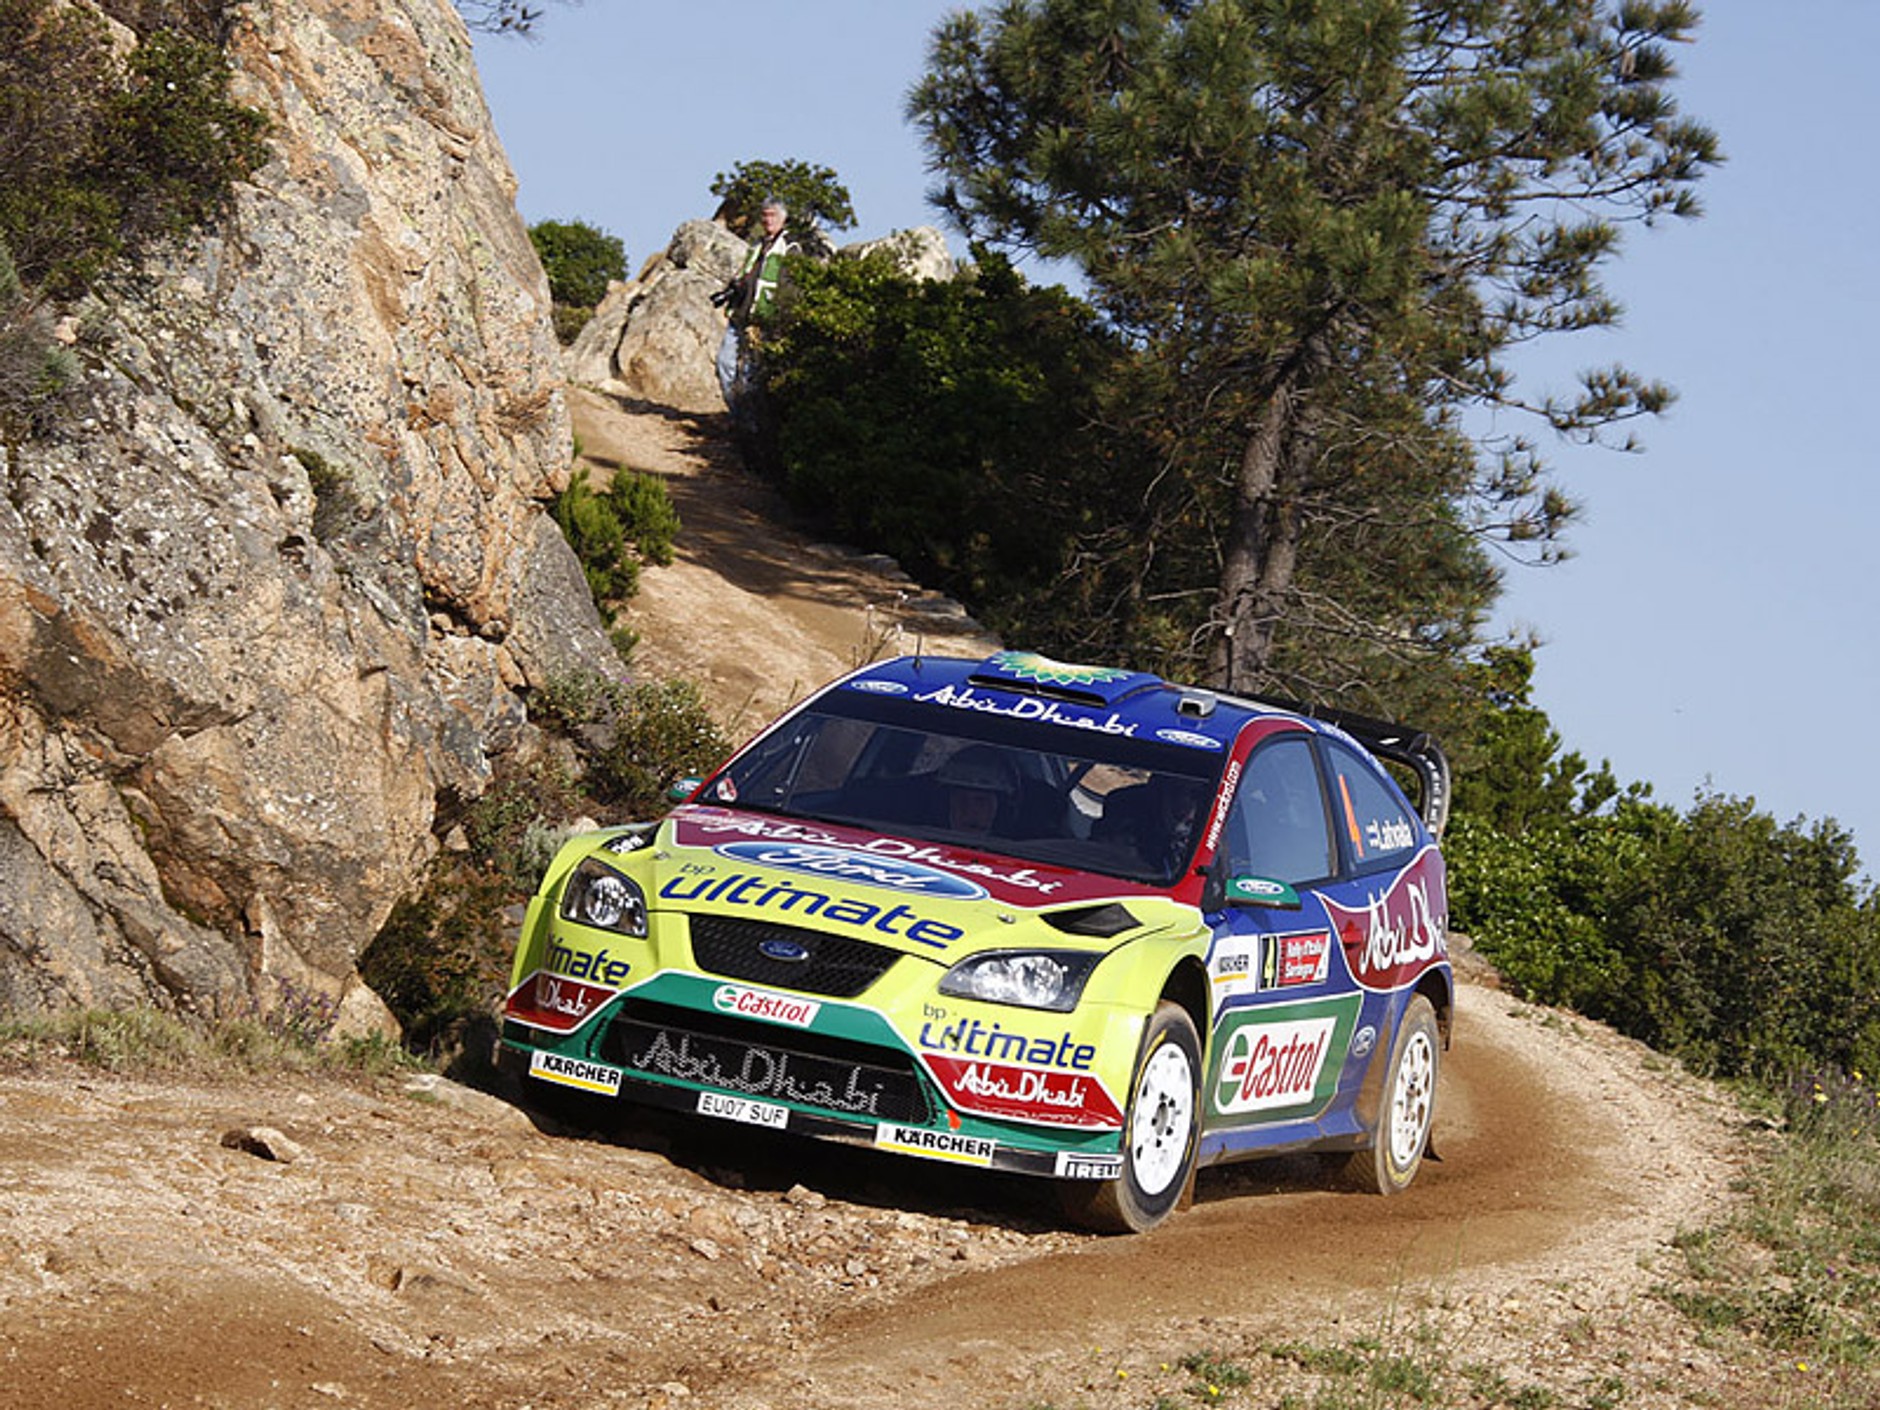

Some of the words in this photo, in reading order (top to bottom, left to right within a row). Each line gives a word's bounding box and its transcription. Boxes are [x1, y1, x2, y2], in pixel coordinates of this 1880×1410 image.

[913, 685, 1002, 715] Abu
[1008, 697, 1139, 738] Dhabi
[679, 861, 716, 877] bp
[757, 845, 942, 889] Ford
[863, 838, 1064, 895] Dhabi
[659, 874, 965, 950] ultimate
[737, 991, 810, 1023] Castrol
[923, 1003, 947, 1020] bp
[919, 1018, 1097, 1070] ultimate
[1241, 1029, 1327, 1101] Castrol
[542, 1054, 620, 1086] KÄRCHER
[741, 1048, 884, 1115] Dhabi
[953, 1063, 1015, 1100] Abu
[1018, 1071, 1087, 1108] Dhabi
[701, 1095, 746, 1117] EU07
[750, 1104, 786, 1124] SUF
[894, 1127, 992, 1157] KÄRCHER
